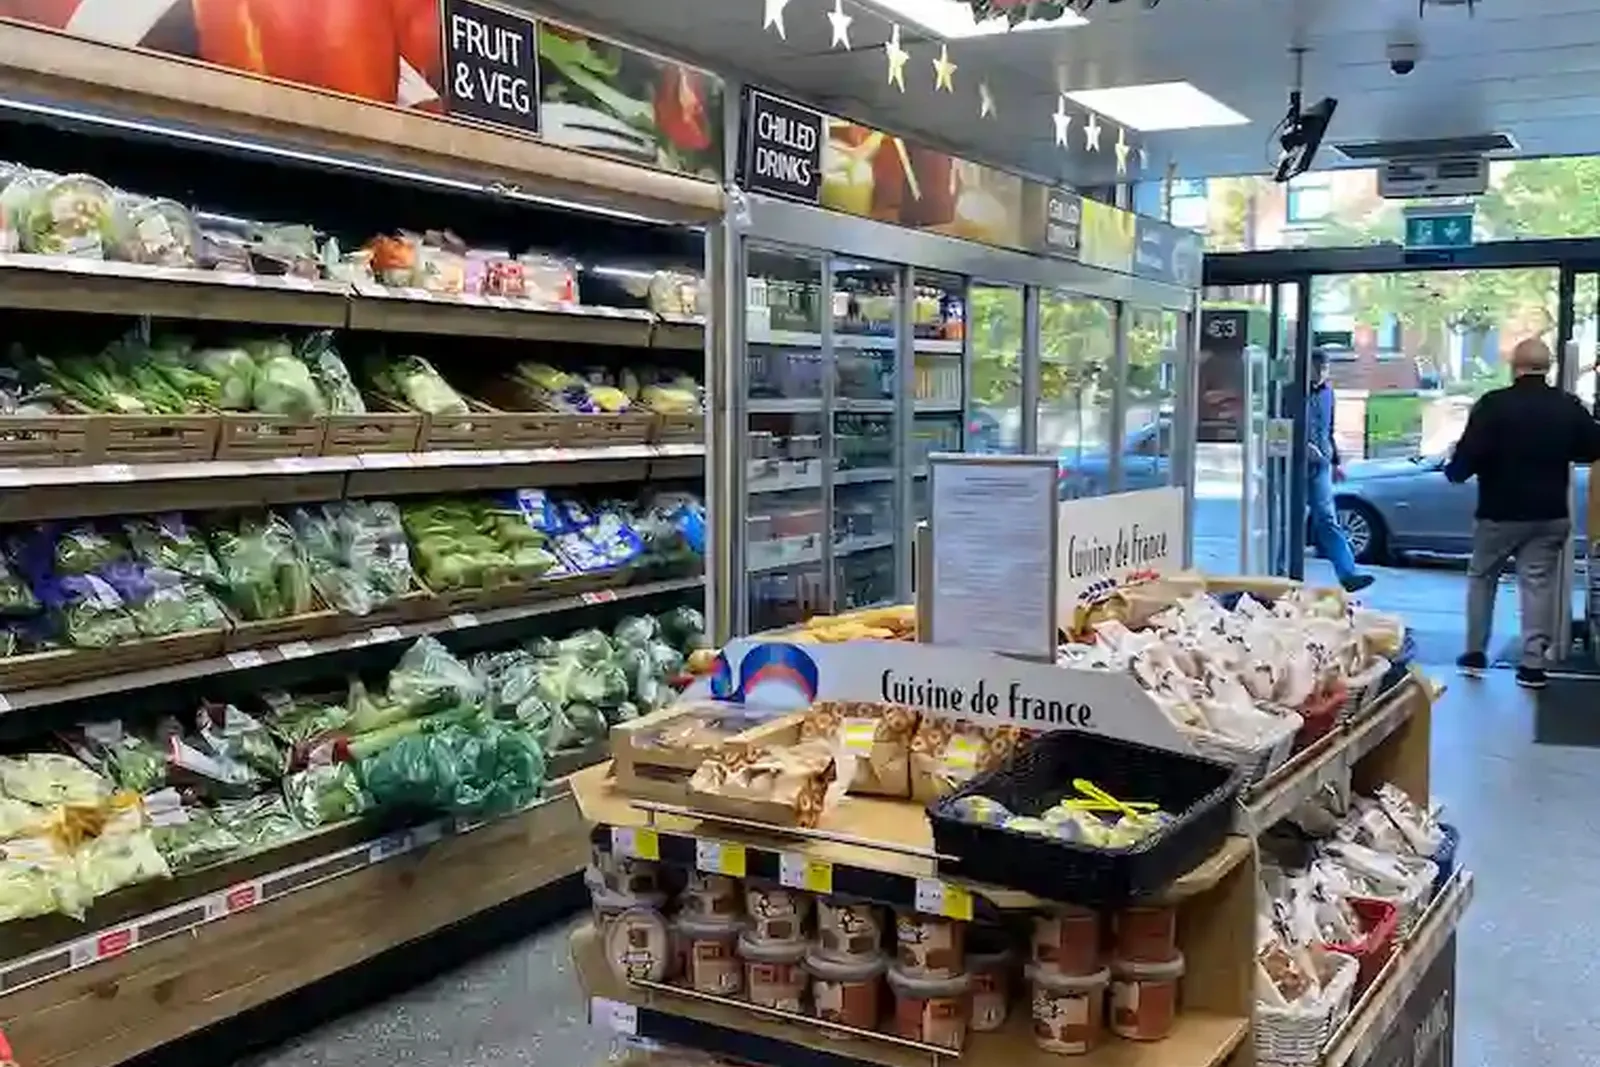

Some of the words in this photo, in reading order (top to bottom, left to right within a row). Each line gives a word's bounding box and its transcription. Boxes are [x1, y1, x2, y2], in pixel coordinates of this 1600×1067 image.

[453, 14, 522, 66] FRUIT
[455, 61, 475, 100] &
[479, 67, 530, 114] VEG
[758, 112, 816, 152] CHILLED
[757, 146, 811, 187] DRINKS
[1069, 534, 1112, 579] Cuisine
[1115, 527, 1128, 568] de
[1131, 523, 1168, 565] France
[881, 668, 963, 712] Cuisine
[971, 679, 998, 716] de
[1009, 683, 1092, 727] France
